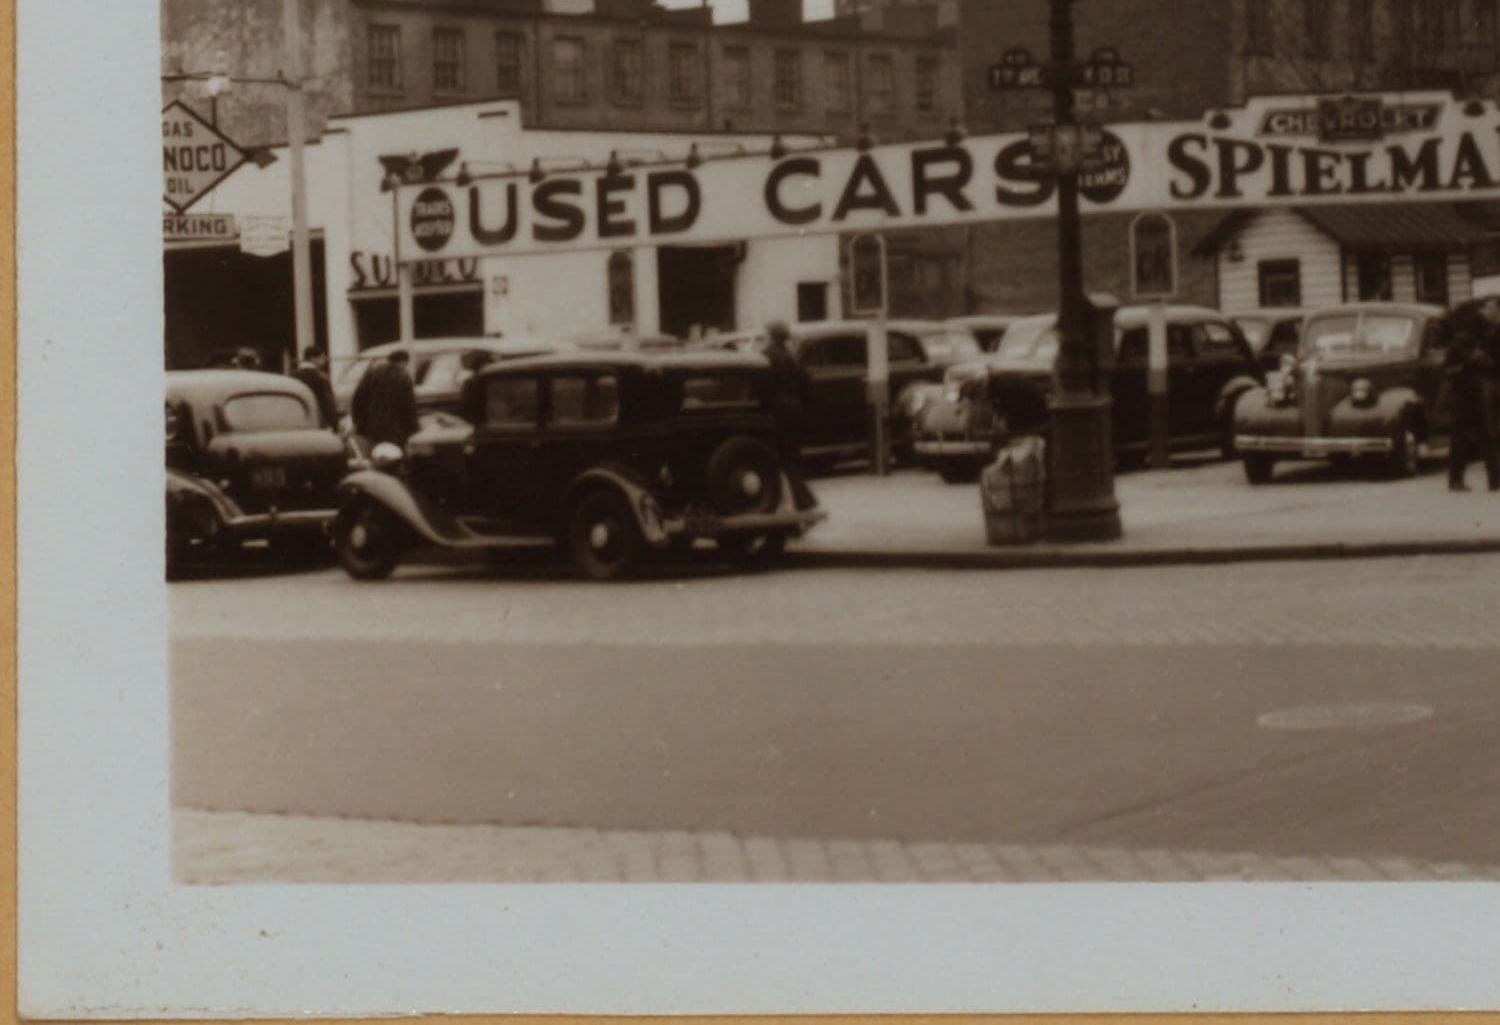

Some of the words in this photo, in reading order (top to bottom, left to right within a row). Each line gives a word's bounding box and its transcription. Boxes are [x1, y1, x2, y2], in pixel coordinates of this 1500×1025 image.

[163, 121, 193, 137] GAS
[167, 178, 194, 194] OIL
[469, 170, 701, 245] USED
[764, 139, 1058, 225] CARS
